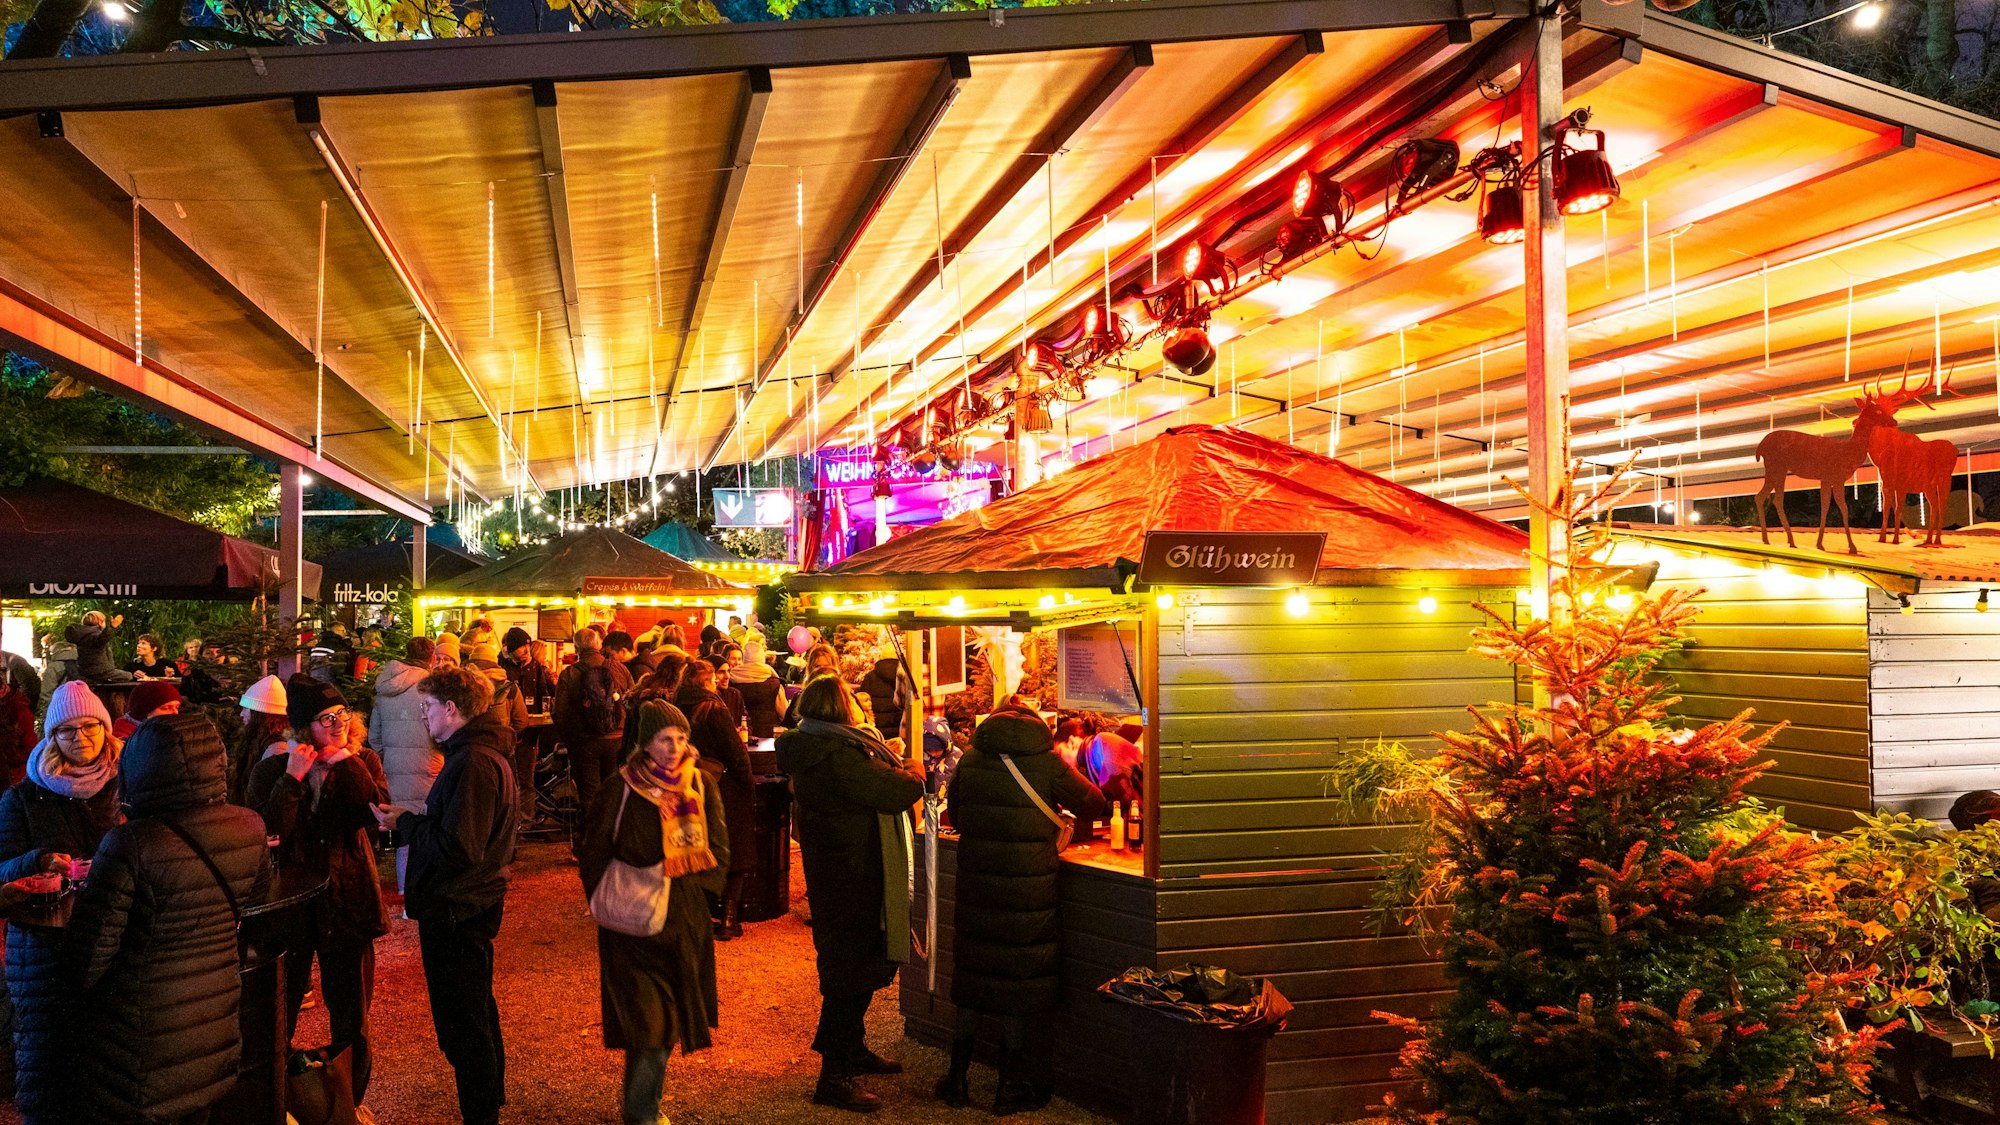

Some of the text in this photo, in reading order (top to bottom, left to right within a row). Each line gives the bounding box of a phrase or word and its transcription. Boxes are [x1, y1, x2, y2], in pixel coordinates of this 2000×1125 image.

[1165, 544, 1296, 574] Glühwein
[333, 583, 399, 603] fritz-kola
[621, 581, 628, 591] &
[629, 582, 666, 592] Waffeln
